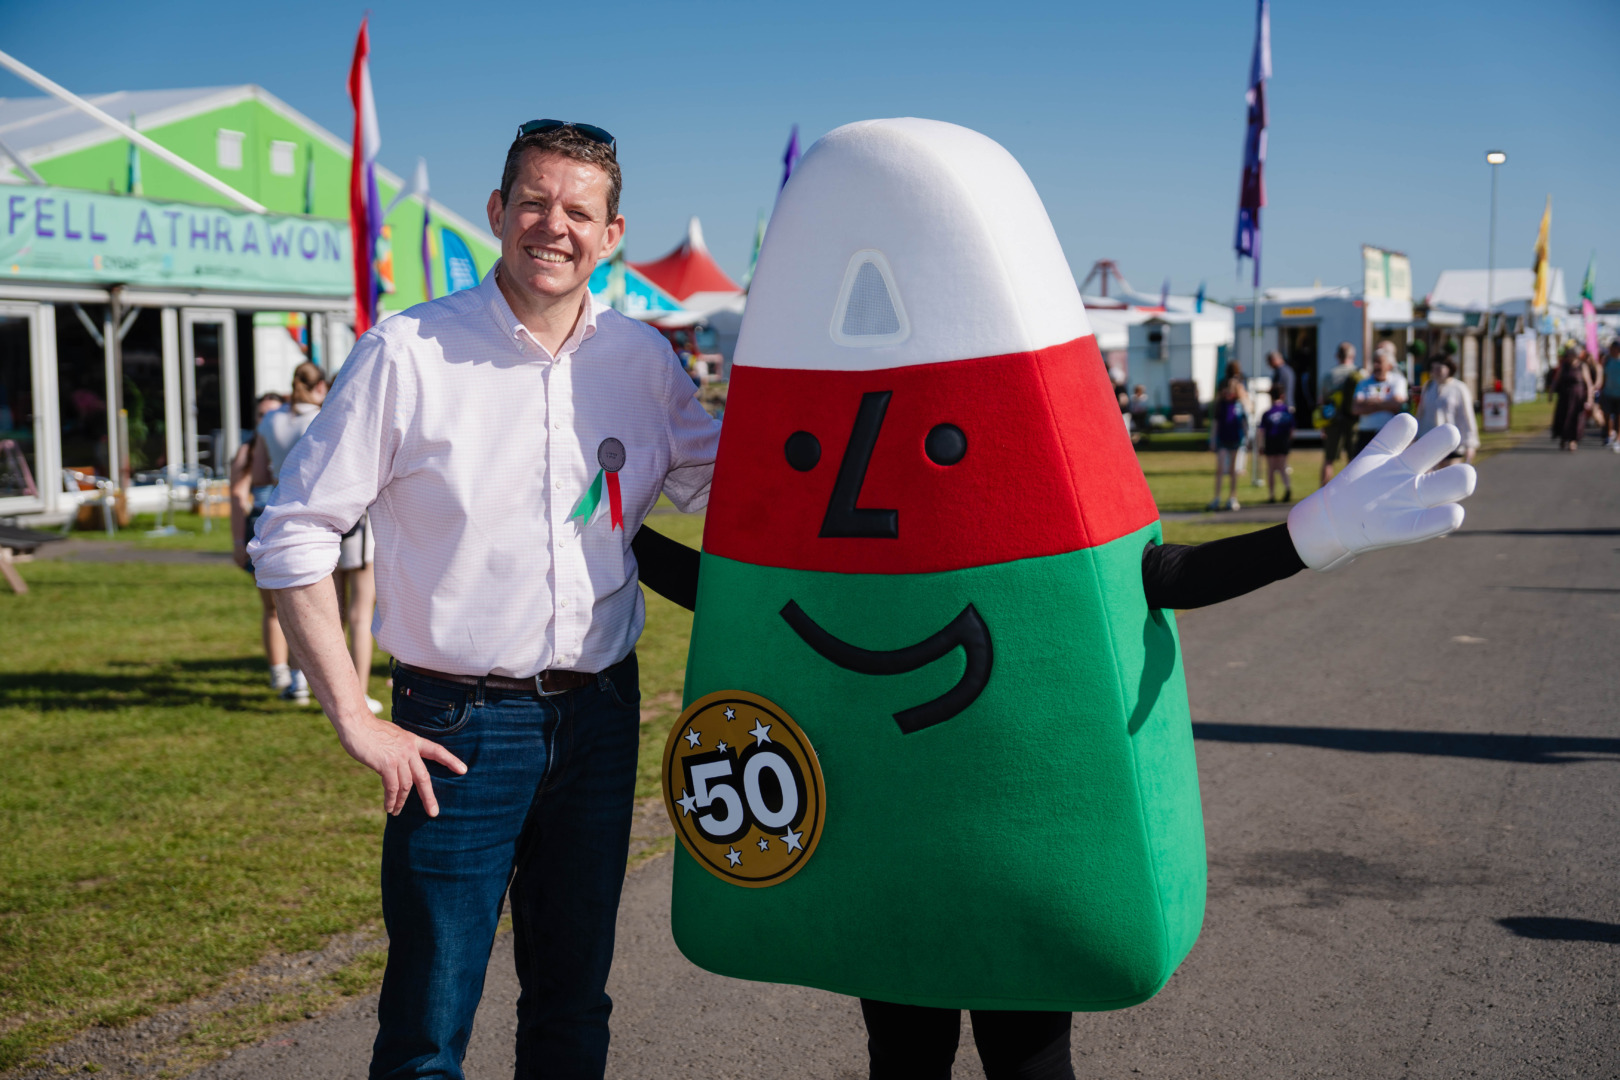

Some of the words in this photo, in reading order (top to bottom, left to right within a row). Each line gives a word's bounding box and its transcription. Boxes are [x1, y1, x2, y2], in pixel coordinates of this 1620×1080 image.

[8, 195, 107, 242] FELL
[134, 208, 341, 261] ATHRAWON
[688, 749, 800, 838] 50
